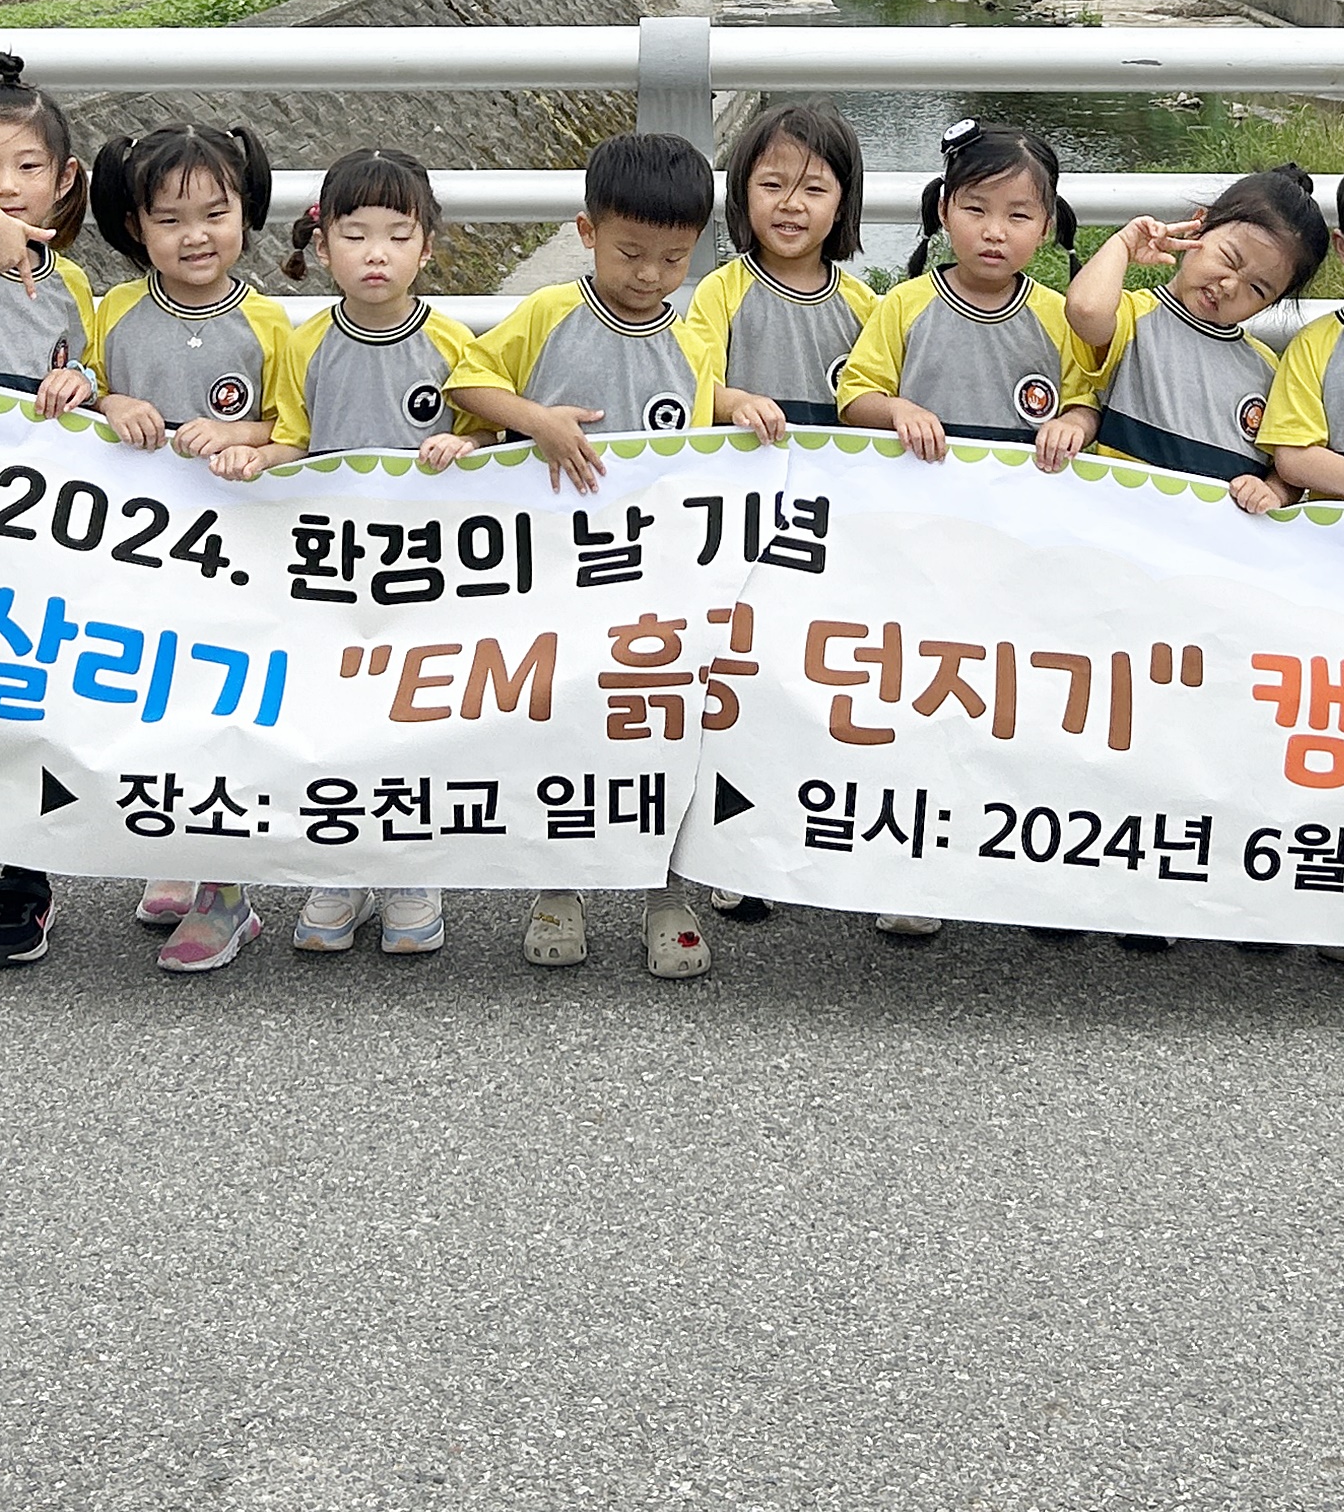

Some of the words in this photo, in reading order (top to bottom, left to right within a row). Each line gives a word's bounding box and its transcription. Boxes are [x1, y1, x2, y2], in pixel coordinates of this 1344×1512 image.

[287, 512, 533, 606] 환경의
[572, 506, 655, 588] 날
[682, 491, 830, 574] 기념
[338, 631, 558, 724] "EM
[803, 620, 1205, 752] 던지기"
[115, 772, 271, 839] 장소:
[298, 776, 508, 846] 웅천교
[535, 771, 667, 841] 일대
[796, 778, 952, 860] 일시:
[977, 801, 1214, 883] 2024년
